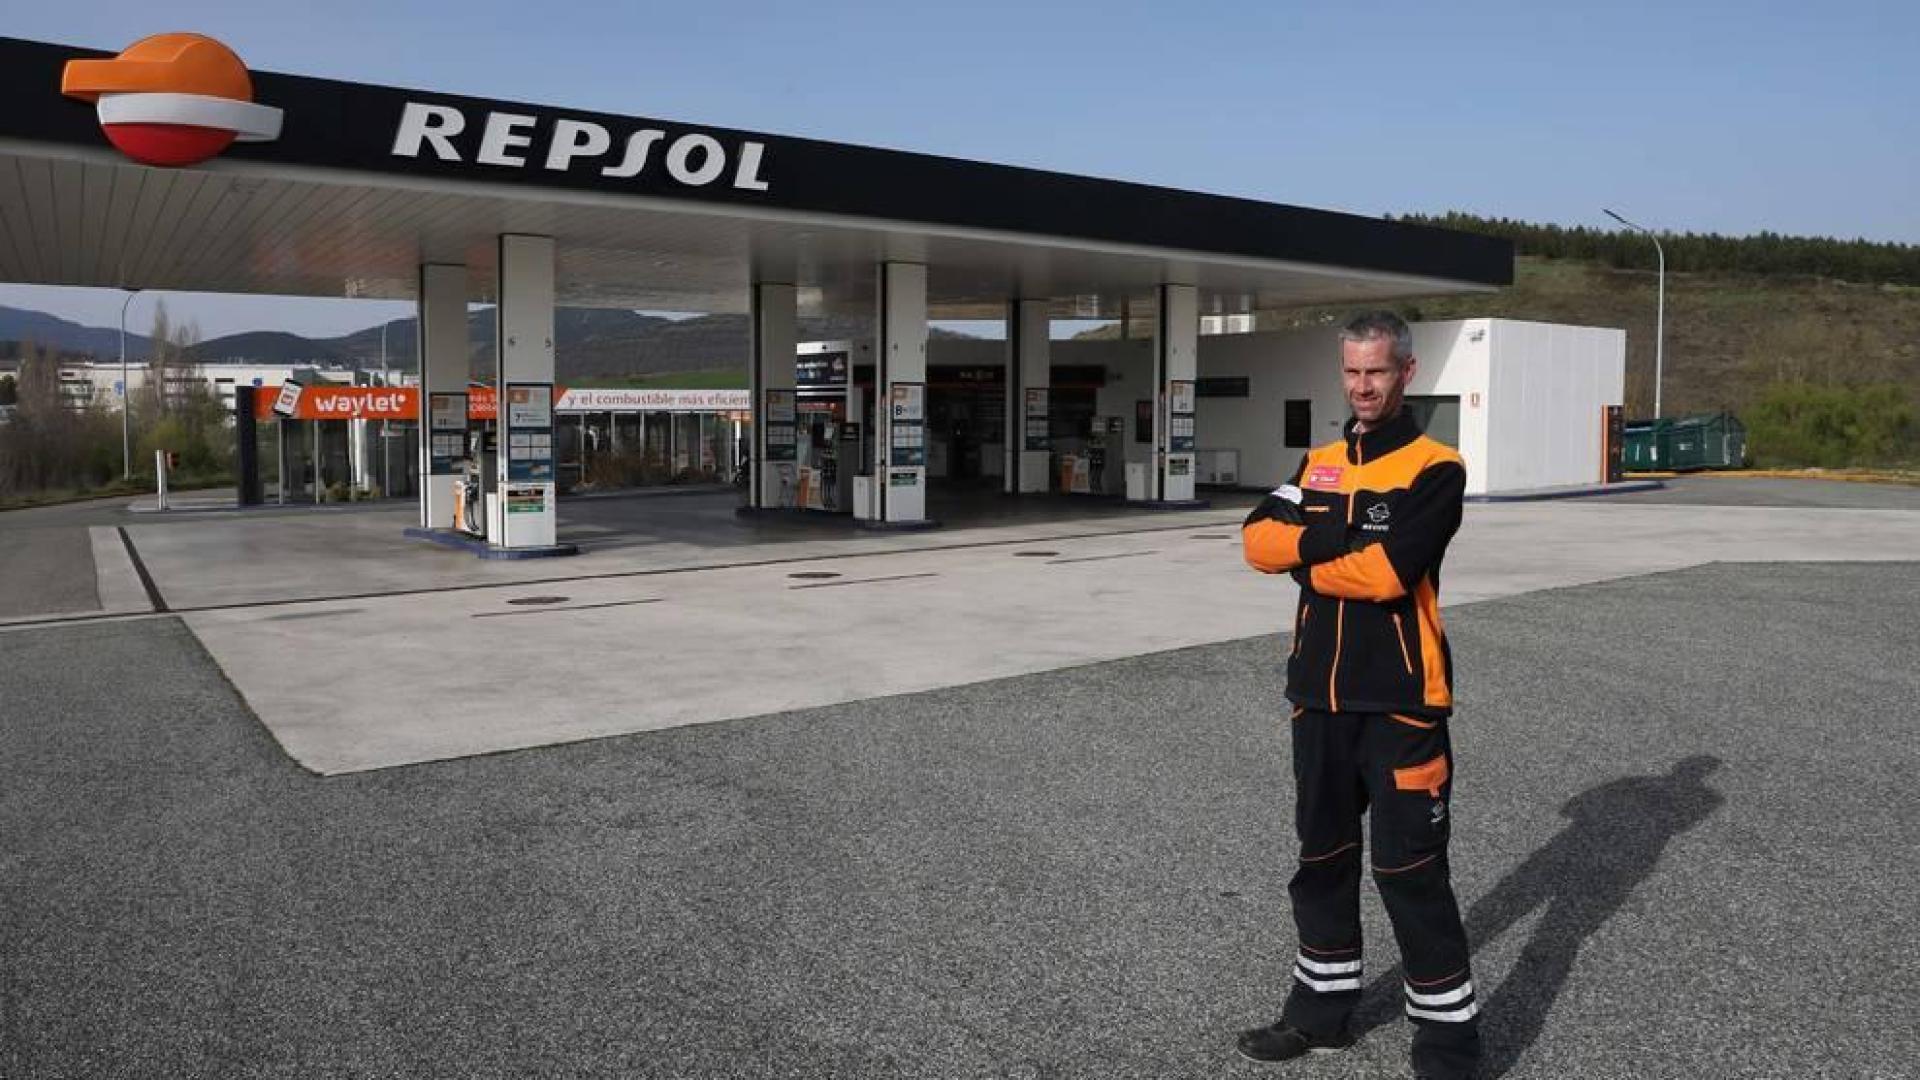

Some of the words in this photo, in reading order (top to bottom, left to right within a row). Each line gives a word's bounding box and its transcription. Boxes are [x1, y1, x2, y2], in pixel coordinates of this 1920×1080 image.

[391, 101, 769, 190] REPSOL
[314, 393, 402, 416] waylet
[581, 393, 593, 405] el
[596, 393, 675, 405] combustible
